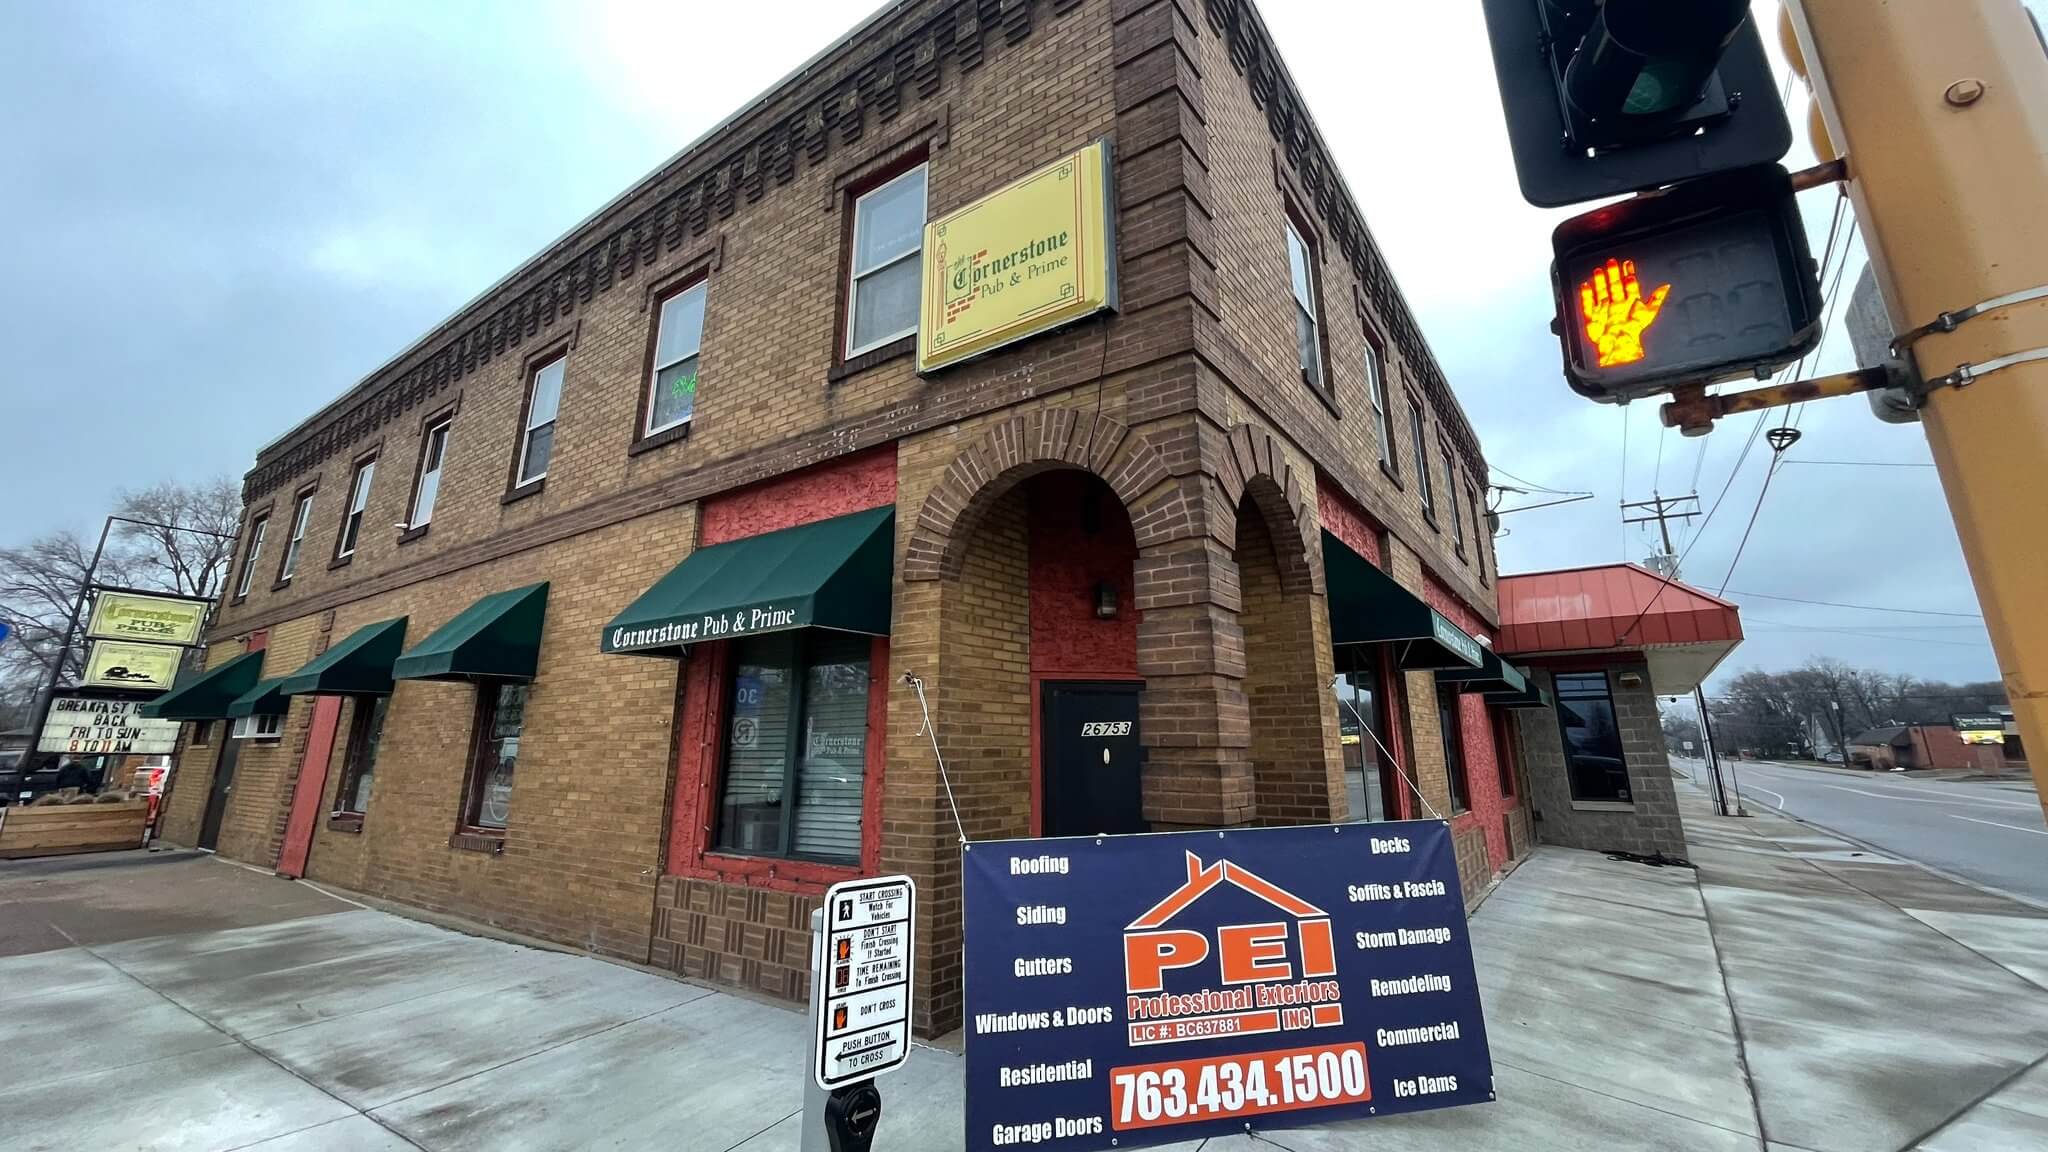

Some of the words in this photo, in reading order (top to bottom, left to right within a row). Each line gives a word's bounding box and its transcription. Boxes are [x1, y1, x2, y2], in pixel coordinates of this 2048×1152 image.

[952, 231, 1069, 290] Cornerstone
[981, 279, 1004, 298] Pub
[1009, 272, 1022, 286] &
[1028, 256, 1068, 280] Prime
[612, 622, 698, 648] Cornerstone
[702, 613, 729, 636] Pub
[732, 611, 746, 632] &
[750, 605, 796, 630] Prime
[56, 700, 130, 714] BREAKFAST
[93, 714, 129, 727] BACK
[1083, 722, 1130, 736] 26753
[69, 727, 91, 739] FRI
[97, 727, 113, 739] TO
[69, 740, 79, 752] 8
[83, 740, 98, 752] TO
[101, 741, 111, 752] 11
[113, 741, 132, 752] AM
[1370, 837, 1410, 855] Decks
[1010, 855, 1069, 875] Roofing
[860, 891, 875, 901] START
[878, 888, 903, 898] CROSSING
[1348, 883, 1391, 902] Soffits
[1393, 885, 1403, 899] &
[1403, 880, 1446, 898] Fascia
[869, 903, 883, 912] Watch
[885, 900, 893, 909] For
[1016, 905, 1067, 925] Siding
[871, 912, 890, 921] Vehicles
[863, 925, 879, 938] DON'T
[881, 924, 897, 935] START
[1356, 931, 1397, 949] Storm
[1397, 927, 1451, 945] Damage
[861, 940, 876, 950] Finish
[879, 937, 899, 947] Crossing
[874, 947, 892, 957] Started
[1123, 919, 1337, 993] PEI
[857, 966, 869, 976] TIME
[872, 960, 901, 973] REMAINING
[1014, 957, 1072, 978] Gutters
[856, 978, 862, 987] To
[865, 975, 879, 985] Finish
[882, 972, 902, 981] Crossing
[1370, 974, 1451, 997] Remodeling
[860, 1003, 877, 1016] DON'T
[879, 999, 896, 1011] CROSS
[1126, 985, 1253, 1020] Professional
[1255, 980, 1341, 1007] Exteriors
[975, 1010, 1050, 1034] Windows
[1053, 1010, 1065, 1027] &
[1067, 1005, 1113, 1026] Doors
[1282, 1007, 1312, 1031] INC
[1132, 1026, 1156, 1042] LIC
[1159, 1025, 1173, 1039] #:
[1176, 1018, 1241, 1036] BC637881
[1376, 1021, 1460, 1047] Commercial
[843, 1038, 862, 1052] PUSH
[864, 1031, 890, 1046] BUTTON
[848, 1057, 858, 1068] TO
[861, 1051, 883, 1065] CROSS
[1000, 1059, 1093, 1087] Residential
[1115, 1049, 1366, 1123] 763.434.1500
[1393, 1078, 1416, 1097] Ice
[1418, 1075, 1458, 1094] Dams
[992, 1121, 1052, 1145] Garage
[1055, 1116, 1103, 1137] Doors
